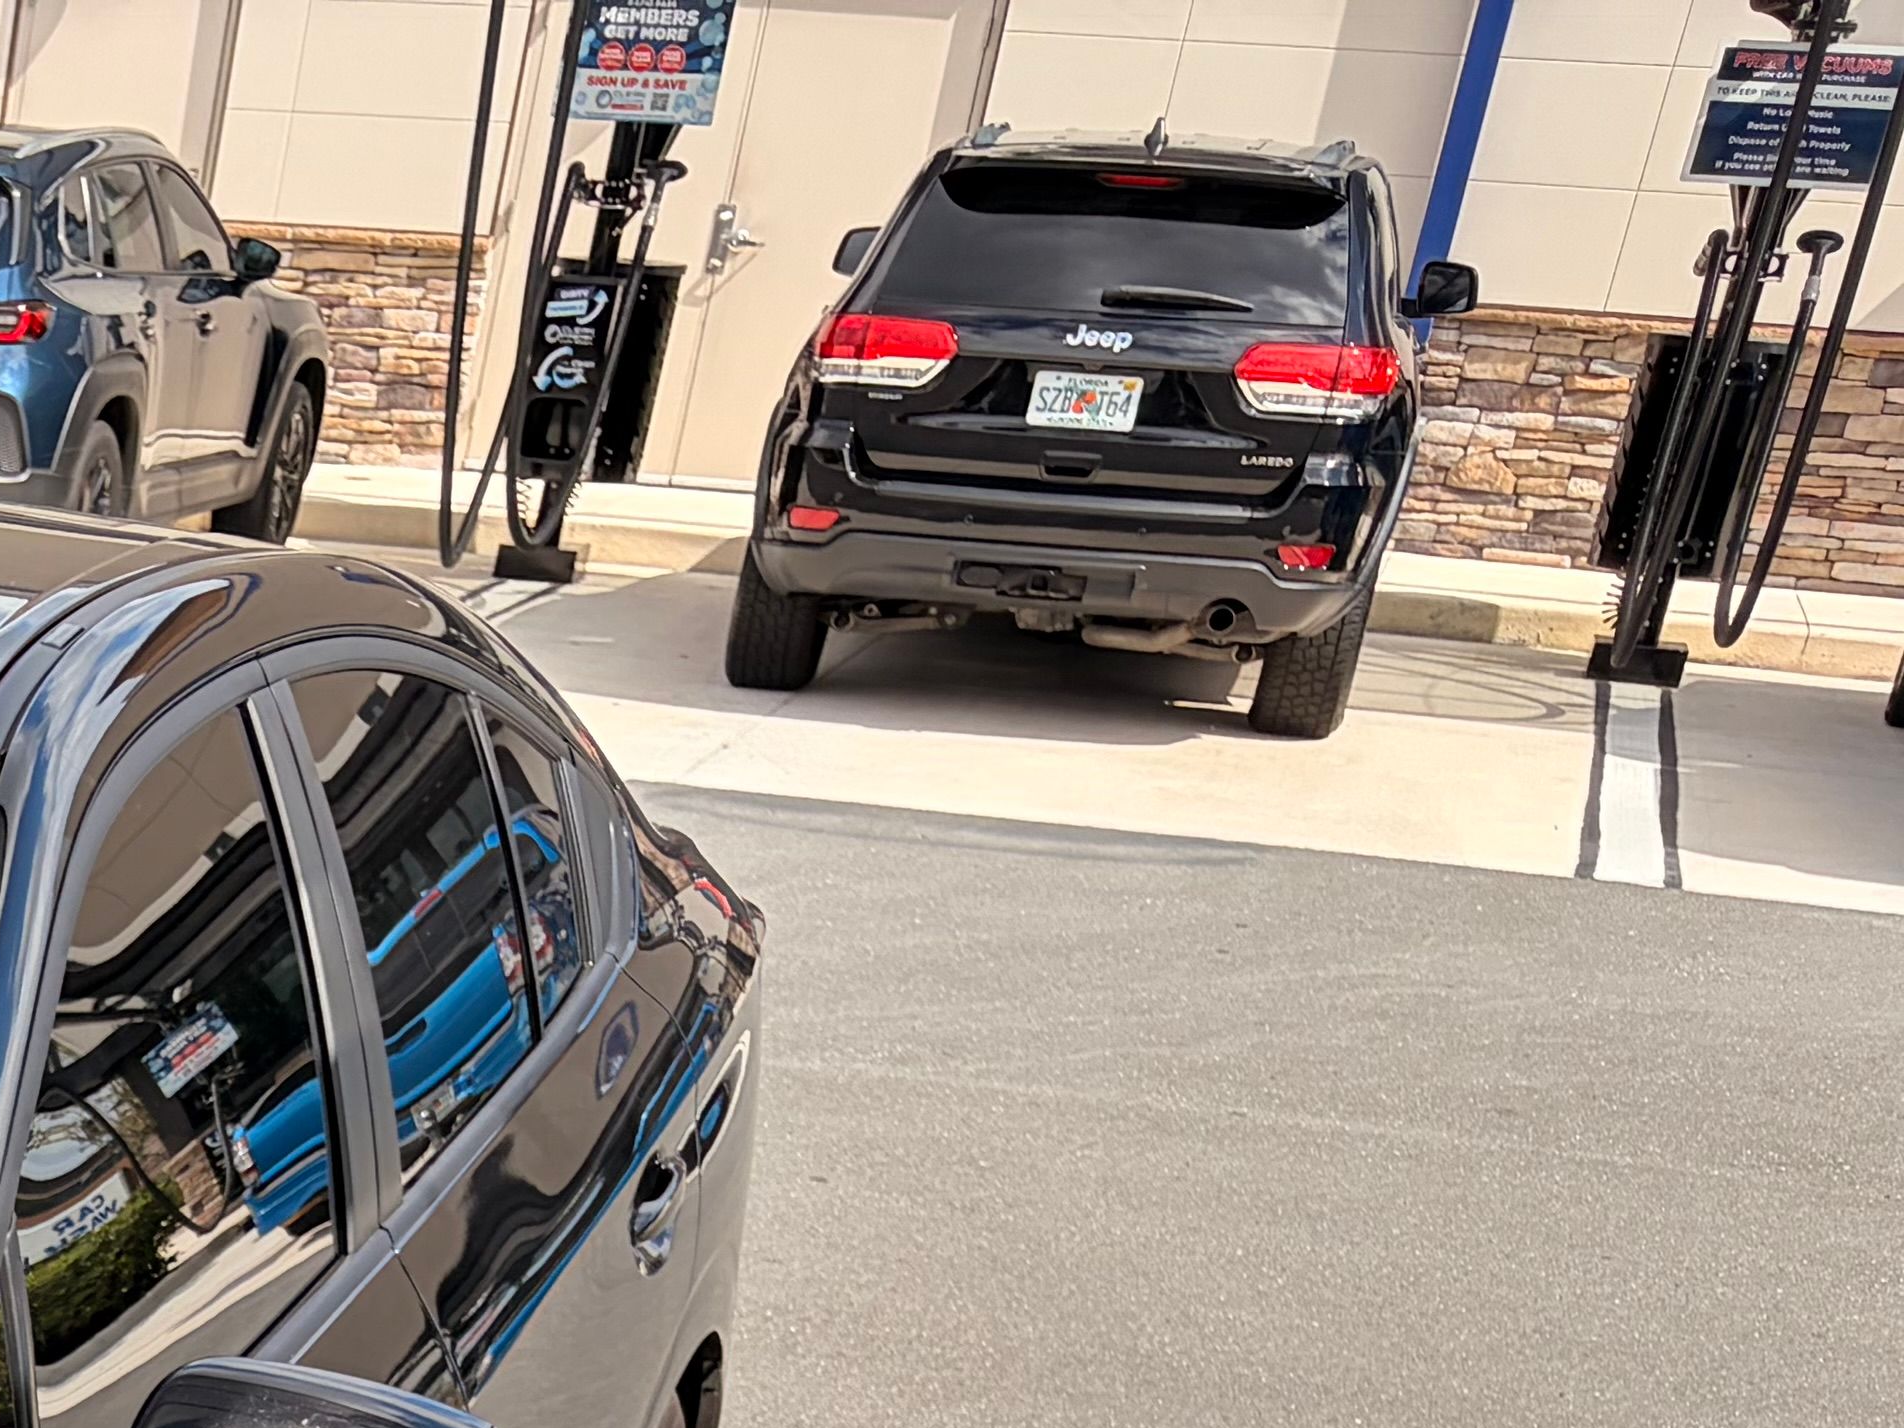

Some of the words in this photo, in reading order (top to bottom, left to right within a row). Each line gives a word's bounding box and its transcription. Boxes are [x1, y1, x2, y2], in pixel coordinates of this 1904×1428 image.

[599, 6, 700, 27] MEMBERS
[604, 25, 638, 39] GET
[640, 27, 690, 42] MORE
[1733, 52, 1788, 70] FREE
[1794, 54, 1894, 75] VCUUMS
[586, 75, 618, 88] SIGN
[621, 77, 639, 88] UP
[653, 79, 688, 91] SAVE
[1717, 86, 1729, 96] TO
[1731, 87, 1758, 96] KEEP
[1760, 88, 1781, 97] THIS
[1763, 107, 1778, 116] No
[1747, 122, 1780, 131] Return
[1809, 125, 1841, 135] Towels
[1728, 136, 1767, 147] Dispose
[1809, 140, 1851, 152] Properly
[1733, 152, 1764, 162] Please
[1065, 323, 1134, 353] Jeep
[1240, 454, 1294, 468] LAREDO
